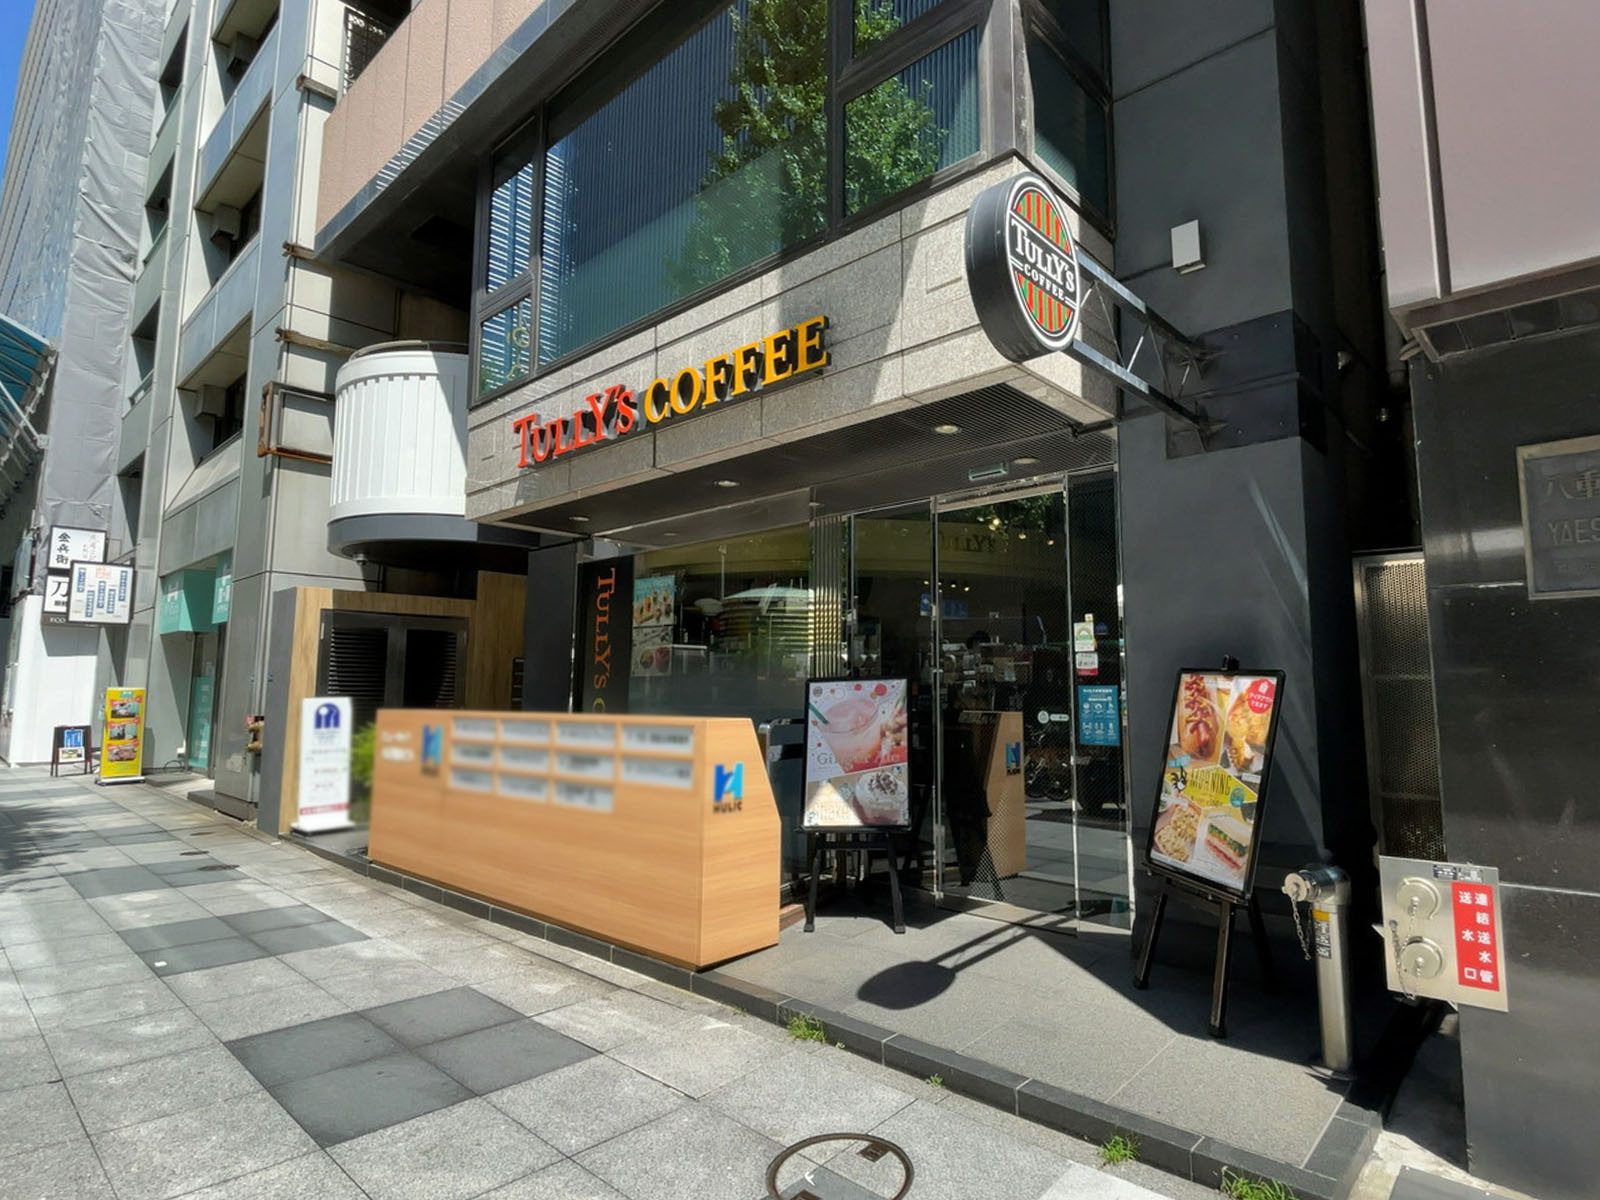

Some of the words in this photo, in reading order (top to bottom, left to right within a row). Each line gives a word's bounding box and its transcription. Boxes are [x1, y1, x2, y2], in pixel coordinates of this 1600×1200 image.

[1011, 218, 1075, 292] TULLY'S
[1024, 263, 1065, 300] COFFEE
[513, 384, 635, 469] TULLY'S
[643, 315, 830, 425] COFFEE
[594, 567, 616, 689] TULLY'S
[1458, 891, 1477, 979] 送水口
